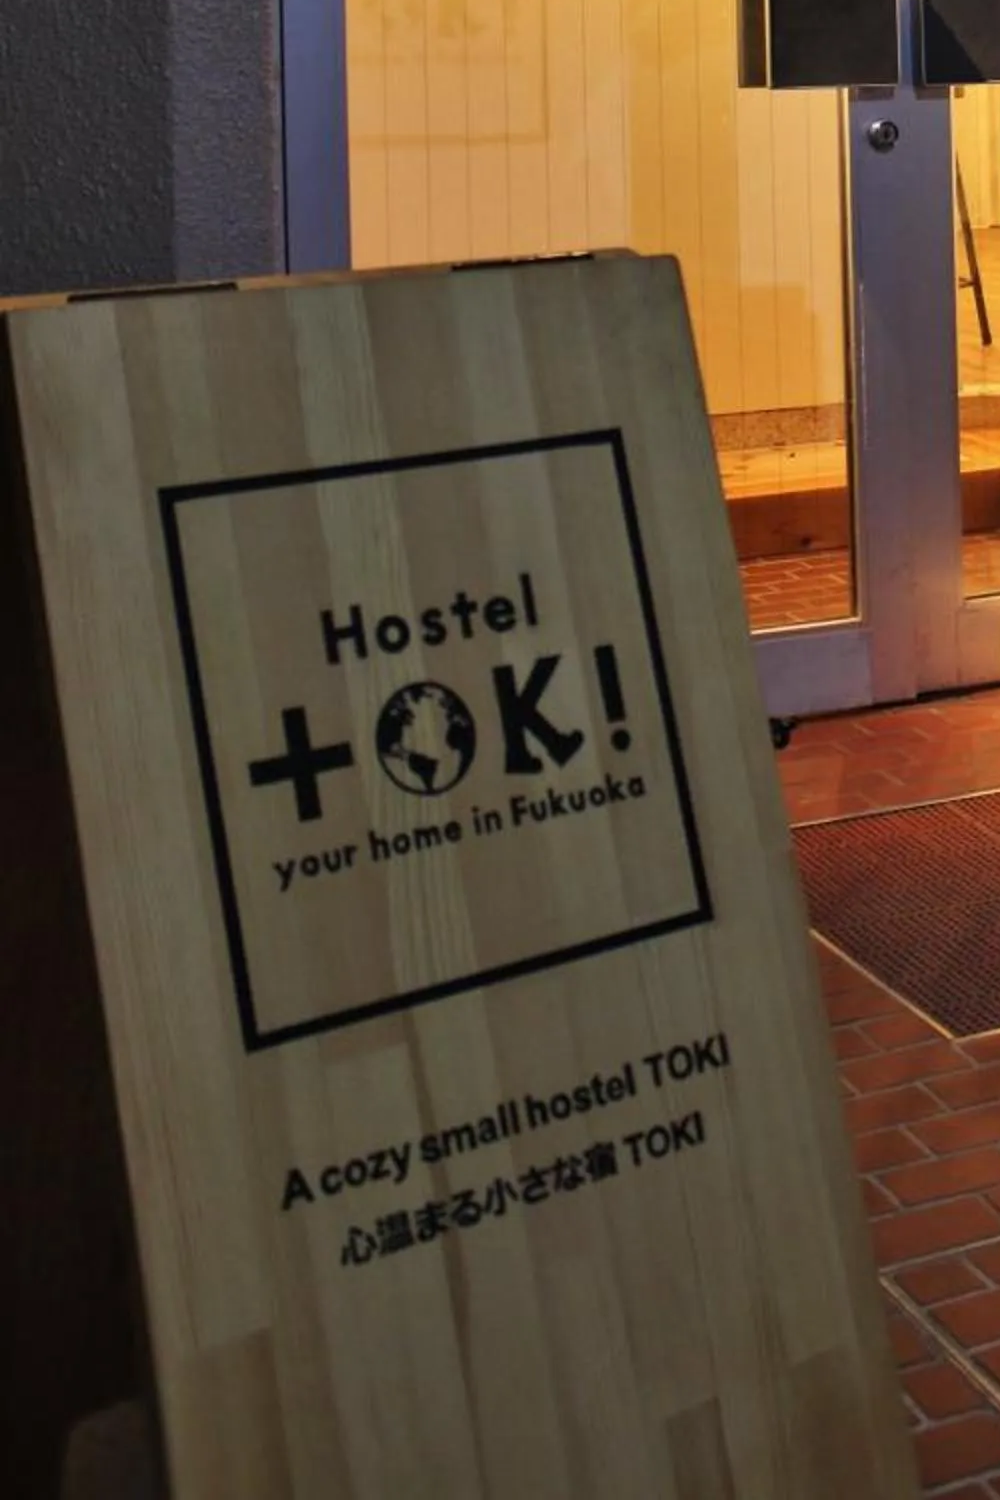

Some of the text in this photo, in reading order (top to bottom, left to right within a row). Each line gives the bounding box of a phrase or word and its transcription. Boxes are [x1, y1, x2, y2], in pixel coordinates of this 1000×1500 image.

[320, 572, 539, 665] Hostel
[272, 774, 646, 891] your home in Fukuoka
[281, 1032, 732, 1211] A cozy small hostel TOKI
[623, 1112, 708, 1170] TOKI
